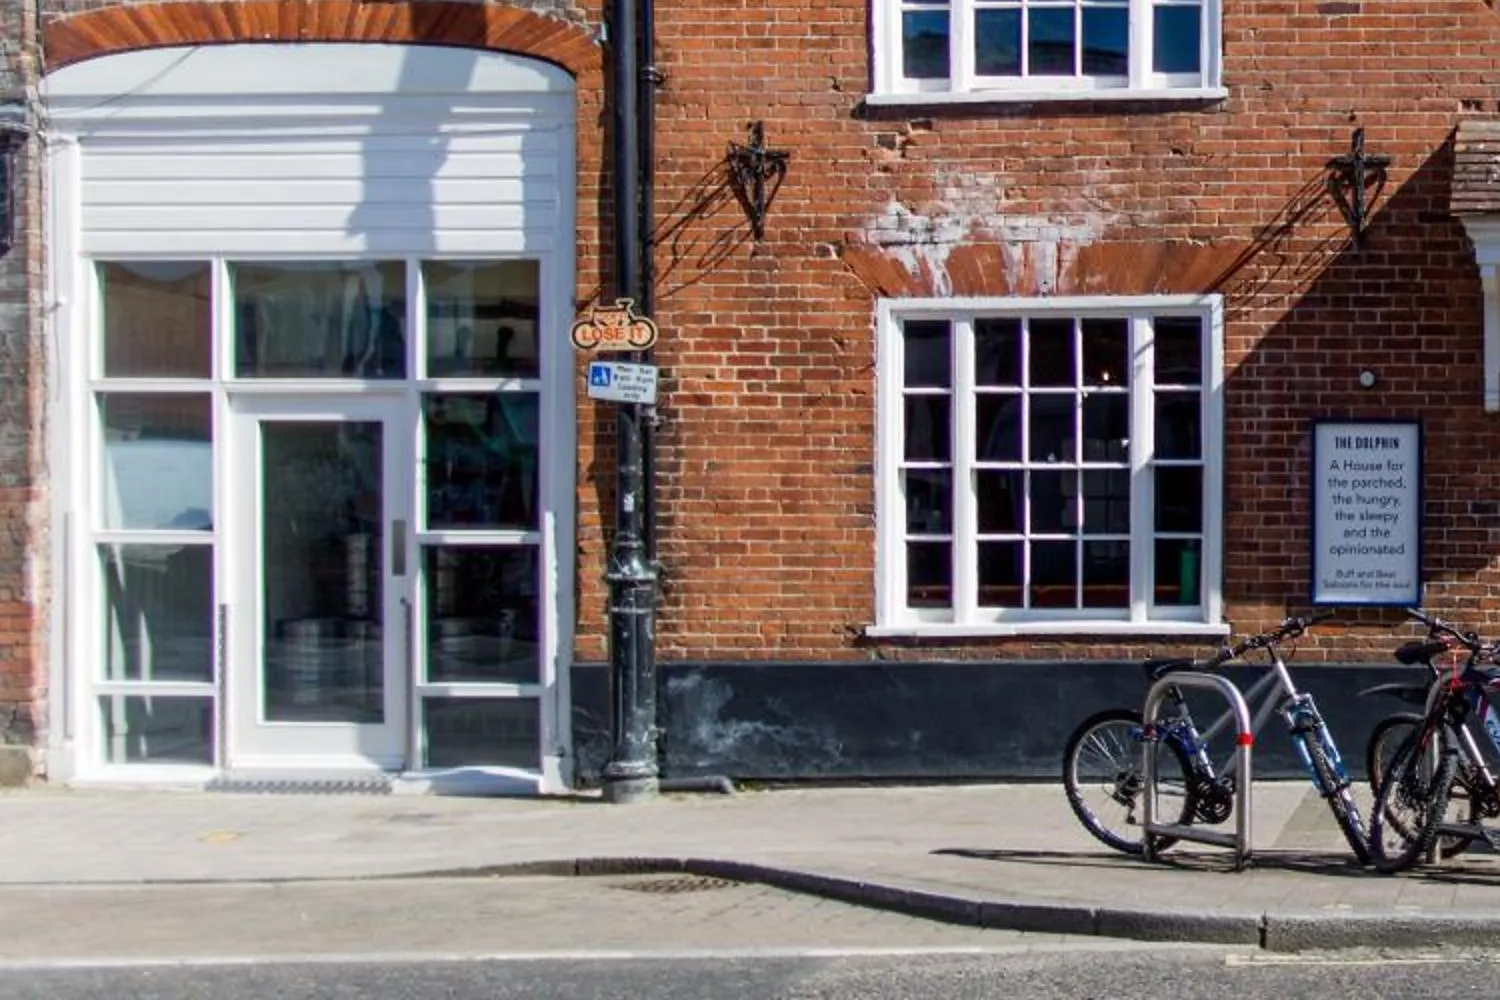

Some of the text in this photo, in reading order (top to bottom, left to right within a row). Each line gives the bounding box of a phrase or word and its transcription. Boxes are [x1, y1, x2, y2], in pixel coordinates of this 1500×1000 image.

[582, 327, 645, 340] LOSE IT
[1335, 436, 1400, 449] THE DOLPHIN
[1330, 460, 1404, 471] A House for
[1328, 475, 1407, 490] the parched,
[1332, 493, 1352, 504] the
[1335, 510, 1399, 524] the sleepy
[1344, 527, 1390, 538] and the
[1329, 543, 1405, 556] opinionated
